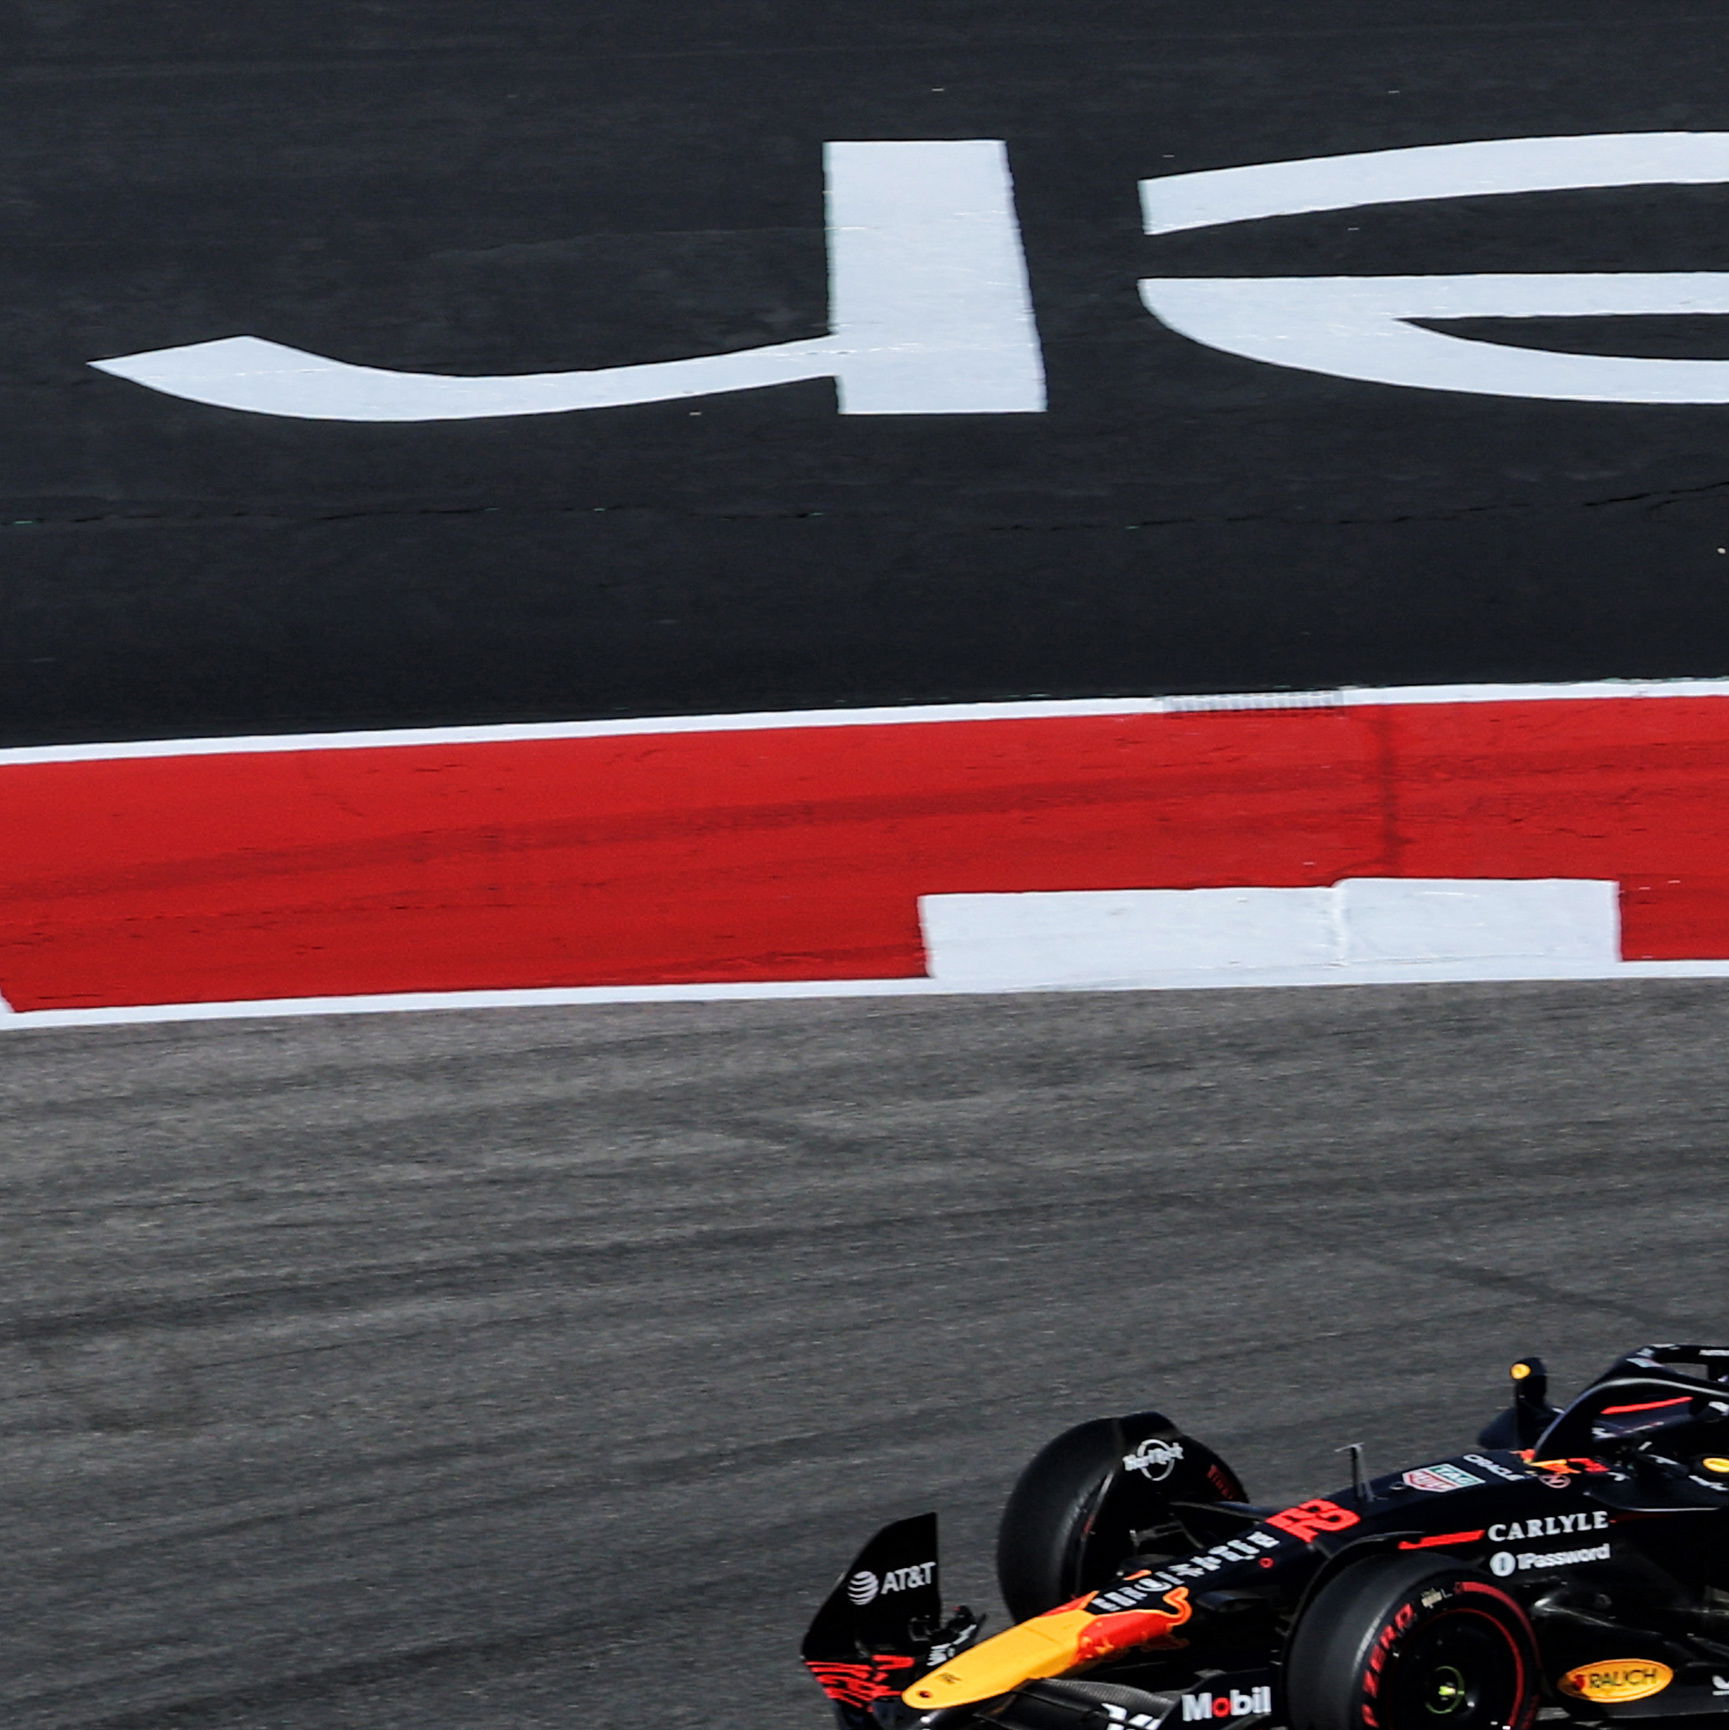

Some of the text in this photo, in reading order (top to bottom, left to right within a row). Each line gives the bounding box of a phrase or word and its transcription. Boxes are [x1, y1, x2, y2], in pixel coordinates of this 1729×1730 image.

[1488, 1511, 1608, 1541] CARLYLE
[880, 1561, 936, 1595] AT&T
[1588, 1668, 1658, 1690] RAUCH
[1181, 1685, 1272, 1722] Mobil
